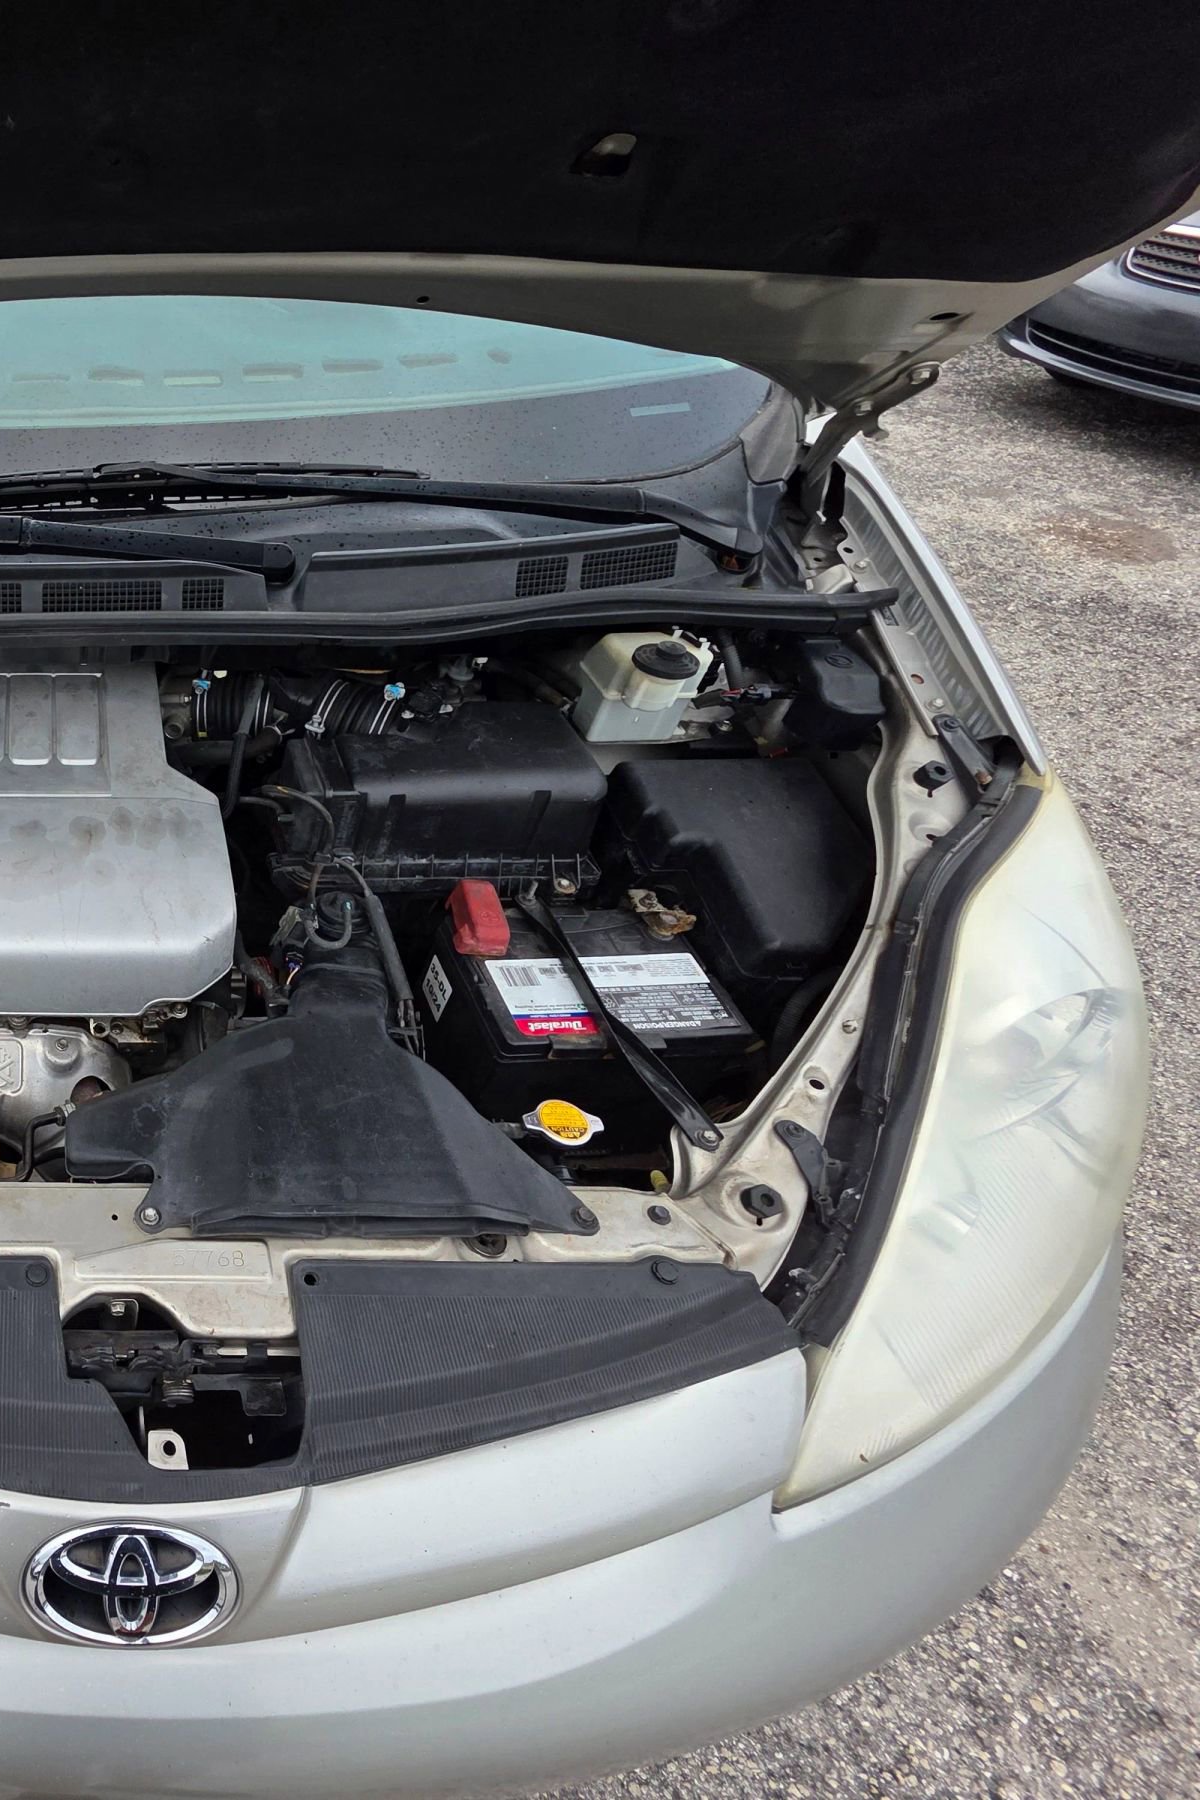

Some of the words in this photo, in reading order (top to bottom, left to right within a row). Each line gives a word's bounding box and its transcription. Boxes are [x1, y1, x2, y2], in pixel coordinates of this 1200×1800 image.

[426, 978, 442, 1013] 10/24
[430, 963, 447, 1001] 35-DL
[528, 1021, 587, 1032] Duralast
